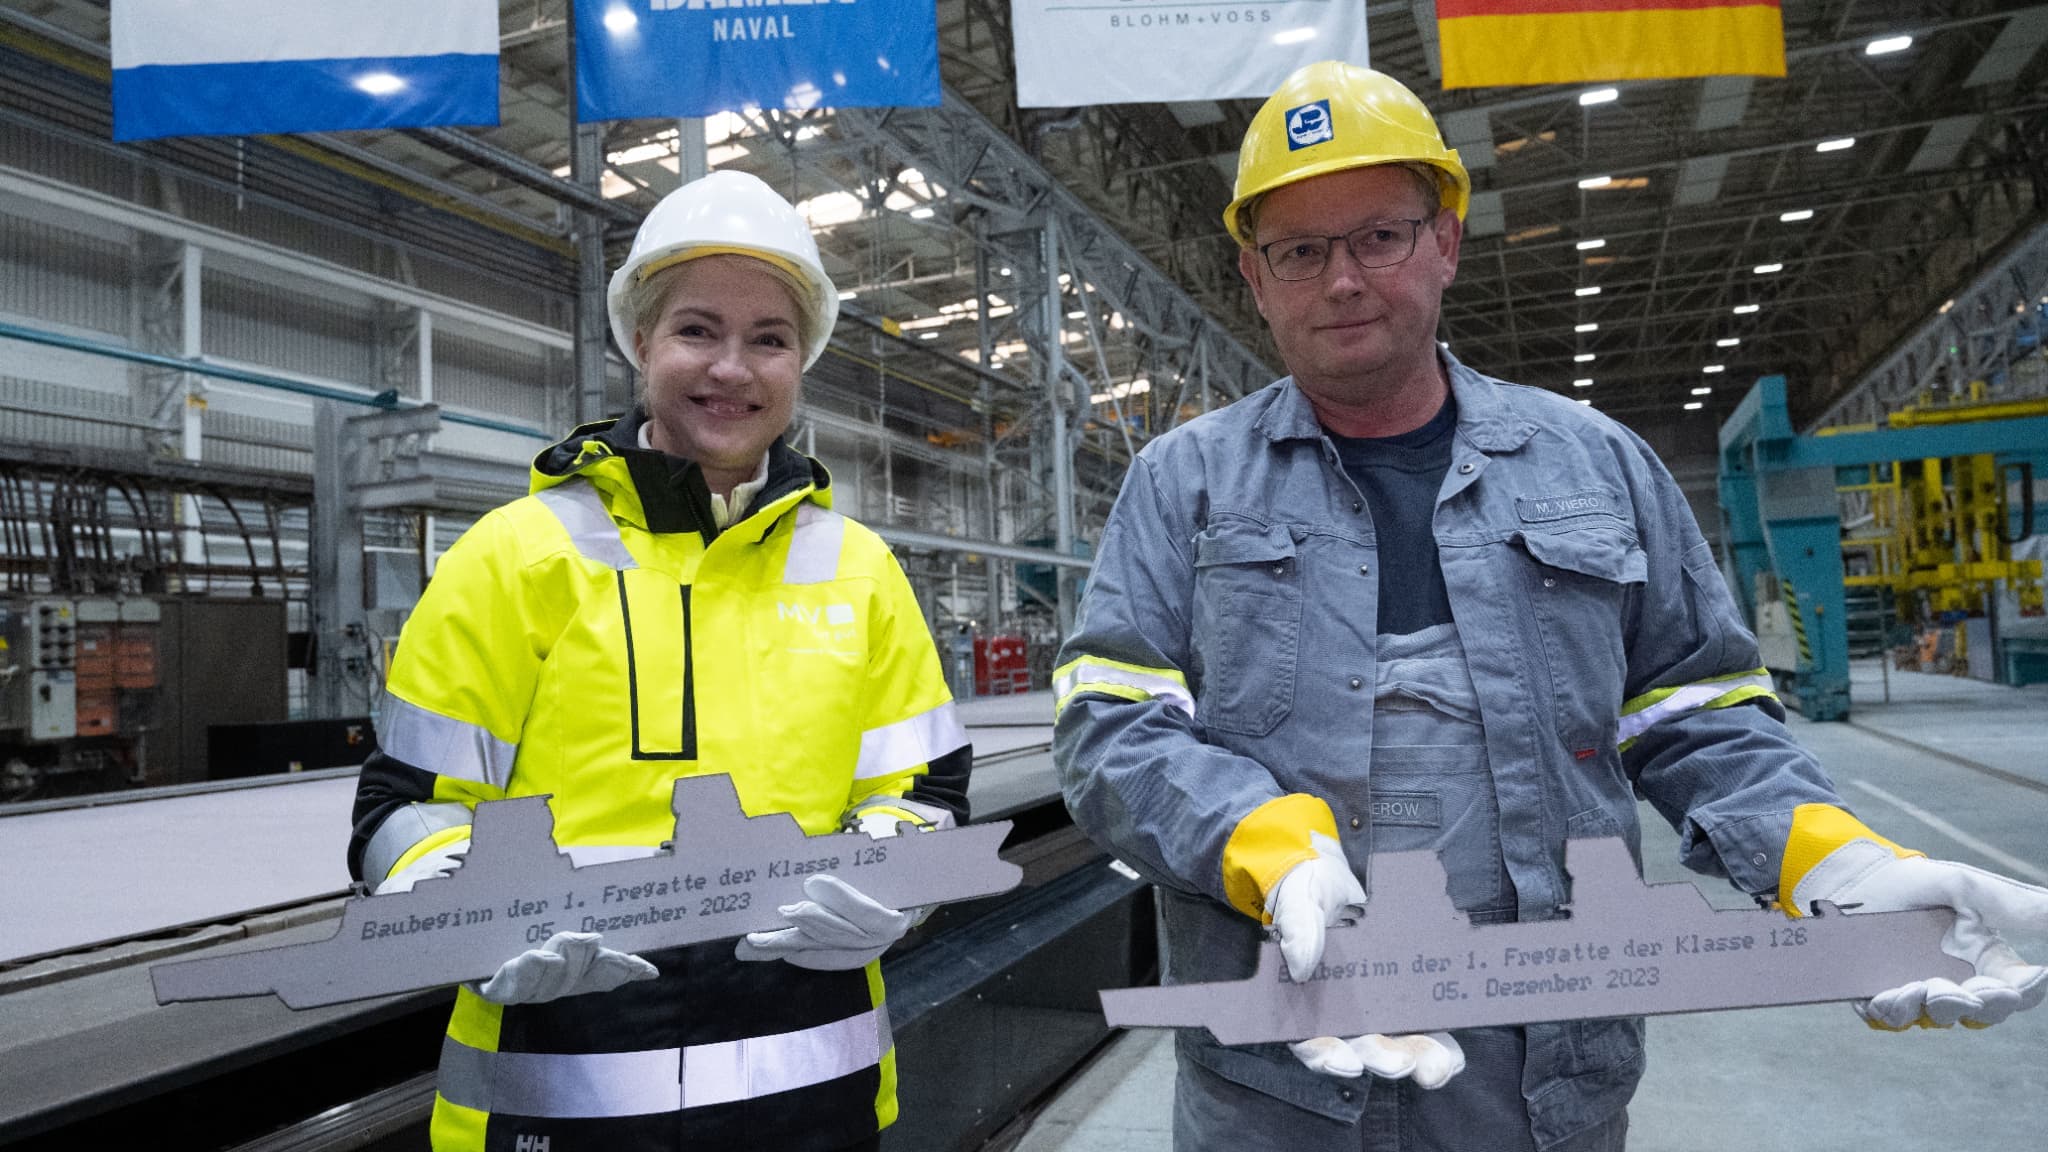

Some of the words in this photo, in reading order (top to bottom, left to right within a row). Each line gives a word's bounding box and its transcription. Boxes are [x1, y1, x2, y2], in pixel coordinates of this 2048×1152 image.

[713, 15, 795, 42] NAVAL
[1556, 497, 1602, 511] VIERO
[777, 601, 822, 625] MV
[1371, 801, 1419, 816] EROW
[361, 906, 494, 941] Baubeginn
[507, 898, 549, 919] der
[563, 891, 585, 910] 1.
[602, 875, 708, 904] Fregatte
[719, 867, 757, 887] der
[768, 854, 841, 879] Klasse
[853, 845, 888, 867] 126
[580, 905, 687, 934] Dezember
[699, 891, 752, 917] 2023
[1411, 953, 1452, 974] der
[1465, 951, 1488, 971] 1.
[1504, 942, 1612, 968] Fregatte
[1623, 938, 1664, 958] der
[1675, 933, 1755, 955] Klasse
[1768, 926, 1809, 948] 126
[1432, 980, 1469, 1002] 05.
[1485, 972, 1593, 999] Dezember
[1605, 966, 1661, 989] 2023
